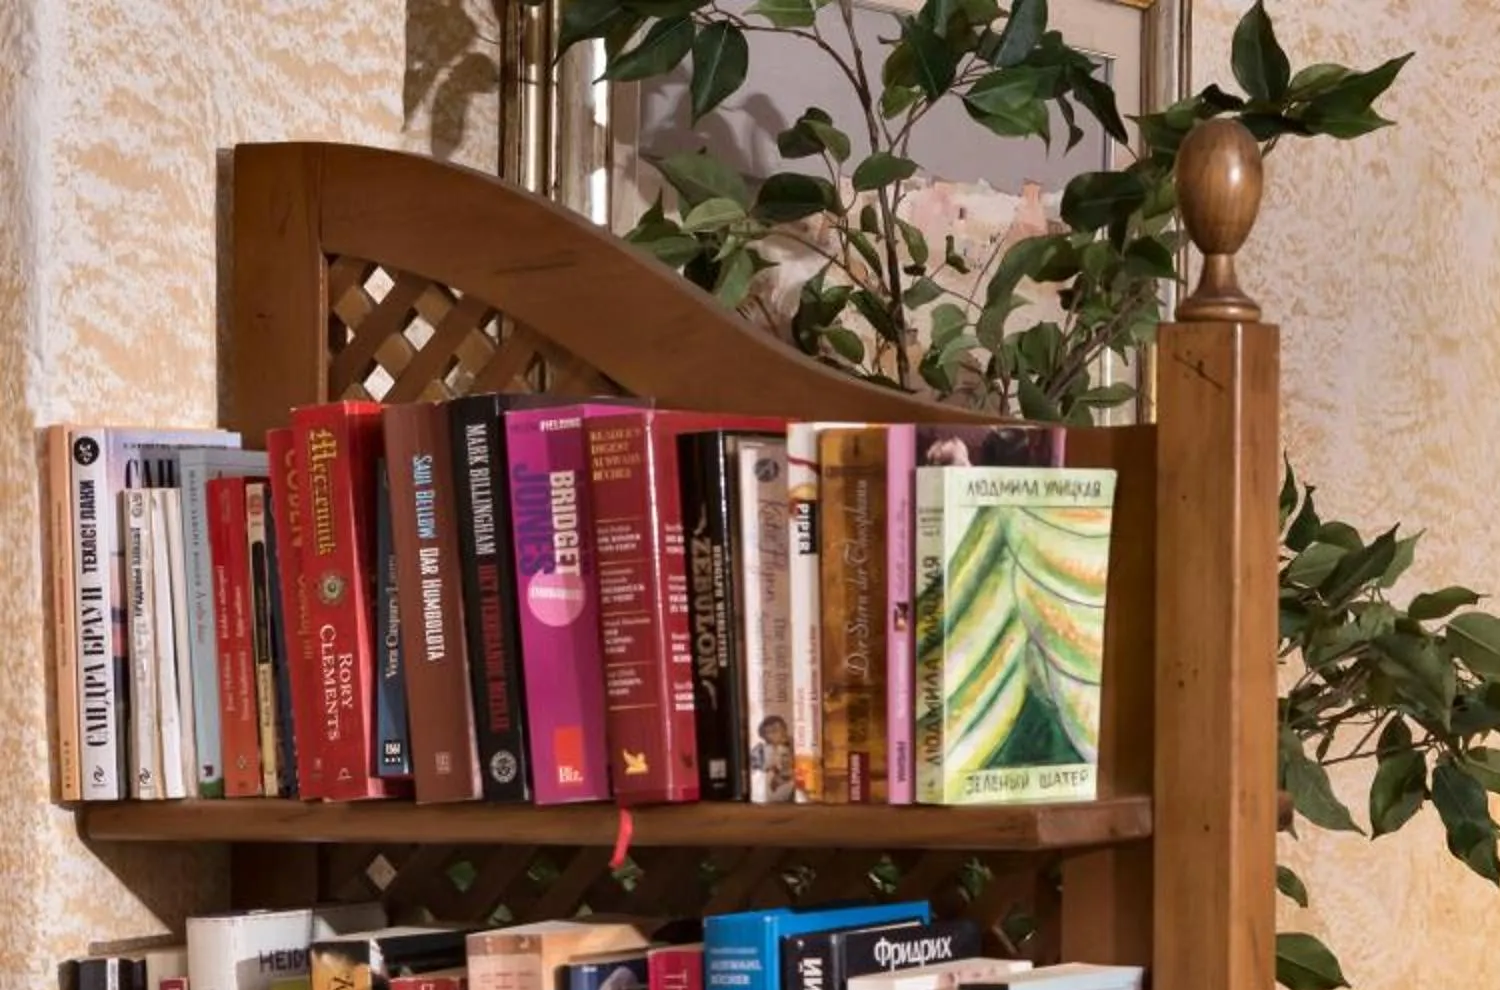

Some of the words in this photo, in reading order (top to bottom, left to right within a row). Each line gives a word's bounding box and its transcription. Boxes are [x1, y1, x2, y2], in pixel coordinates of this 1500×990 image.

[467, 423, 488, 465] MARK
[80, 480, 96, 520] ЛАКИ
[470, 467, 496, 555] BILLINGHAM
[966, 479, 1039, 497] ЛЮДМИЛА
[1043, 479, 1102, 501] УЛИЦКАЯ
[512, 464, 556, 576] JONES
[549, 470, 581, 576] BRIDGET
[799, 503, 811, 553] PIPER
[82, 523, 98, 574] ТЕХАС!
[846, 570, 868, 590] der
[80, 587, 106, 655] БРАУН
[691, 537, 719, 678] ZEBULON
[845, 595, 869, 638] Stern
[319, 624, 341, 741] CLEMENTS
[339, 653, 354, 708] RORY
[385, 650, 398, 679] Vera
[845, 640, 868, 679] Der
[83, 663, 110, 747] САНДРА
[923, 657, 942, 766] ЛЮДМИЛА
[874, 936, 952, 971] Фридрих
